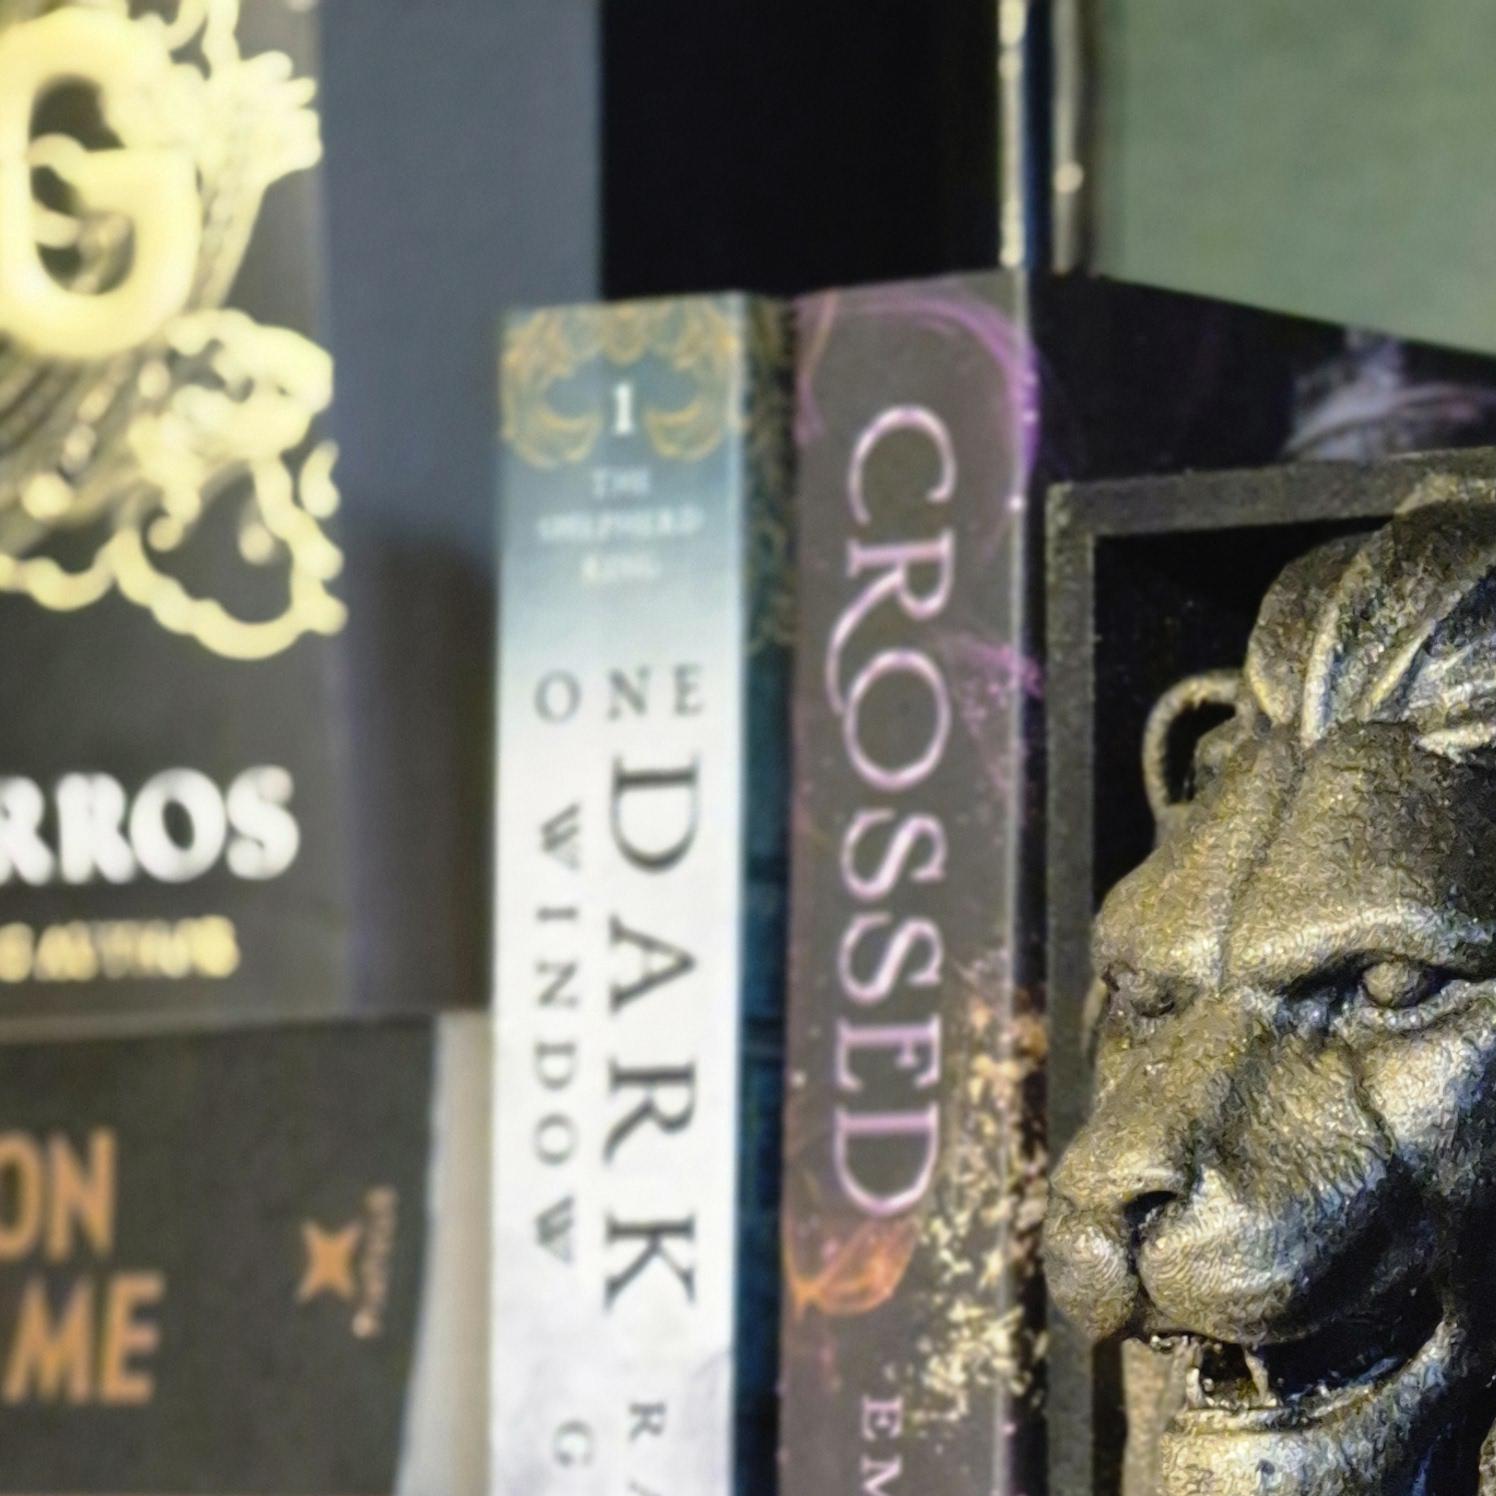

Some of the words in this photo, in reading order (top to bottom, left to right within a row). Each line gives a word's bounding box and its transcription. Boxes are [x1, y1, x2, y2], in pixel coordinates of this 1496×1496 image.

[534, 663, 703, 724] ONE
[826, 405, 956, 1217] CROSSED
[532, 802, 582, 1267] WINDOW
[605, 752, 701, 1312] DARK
[2, 1267, 166, 1408] ME
